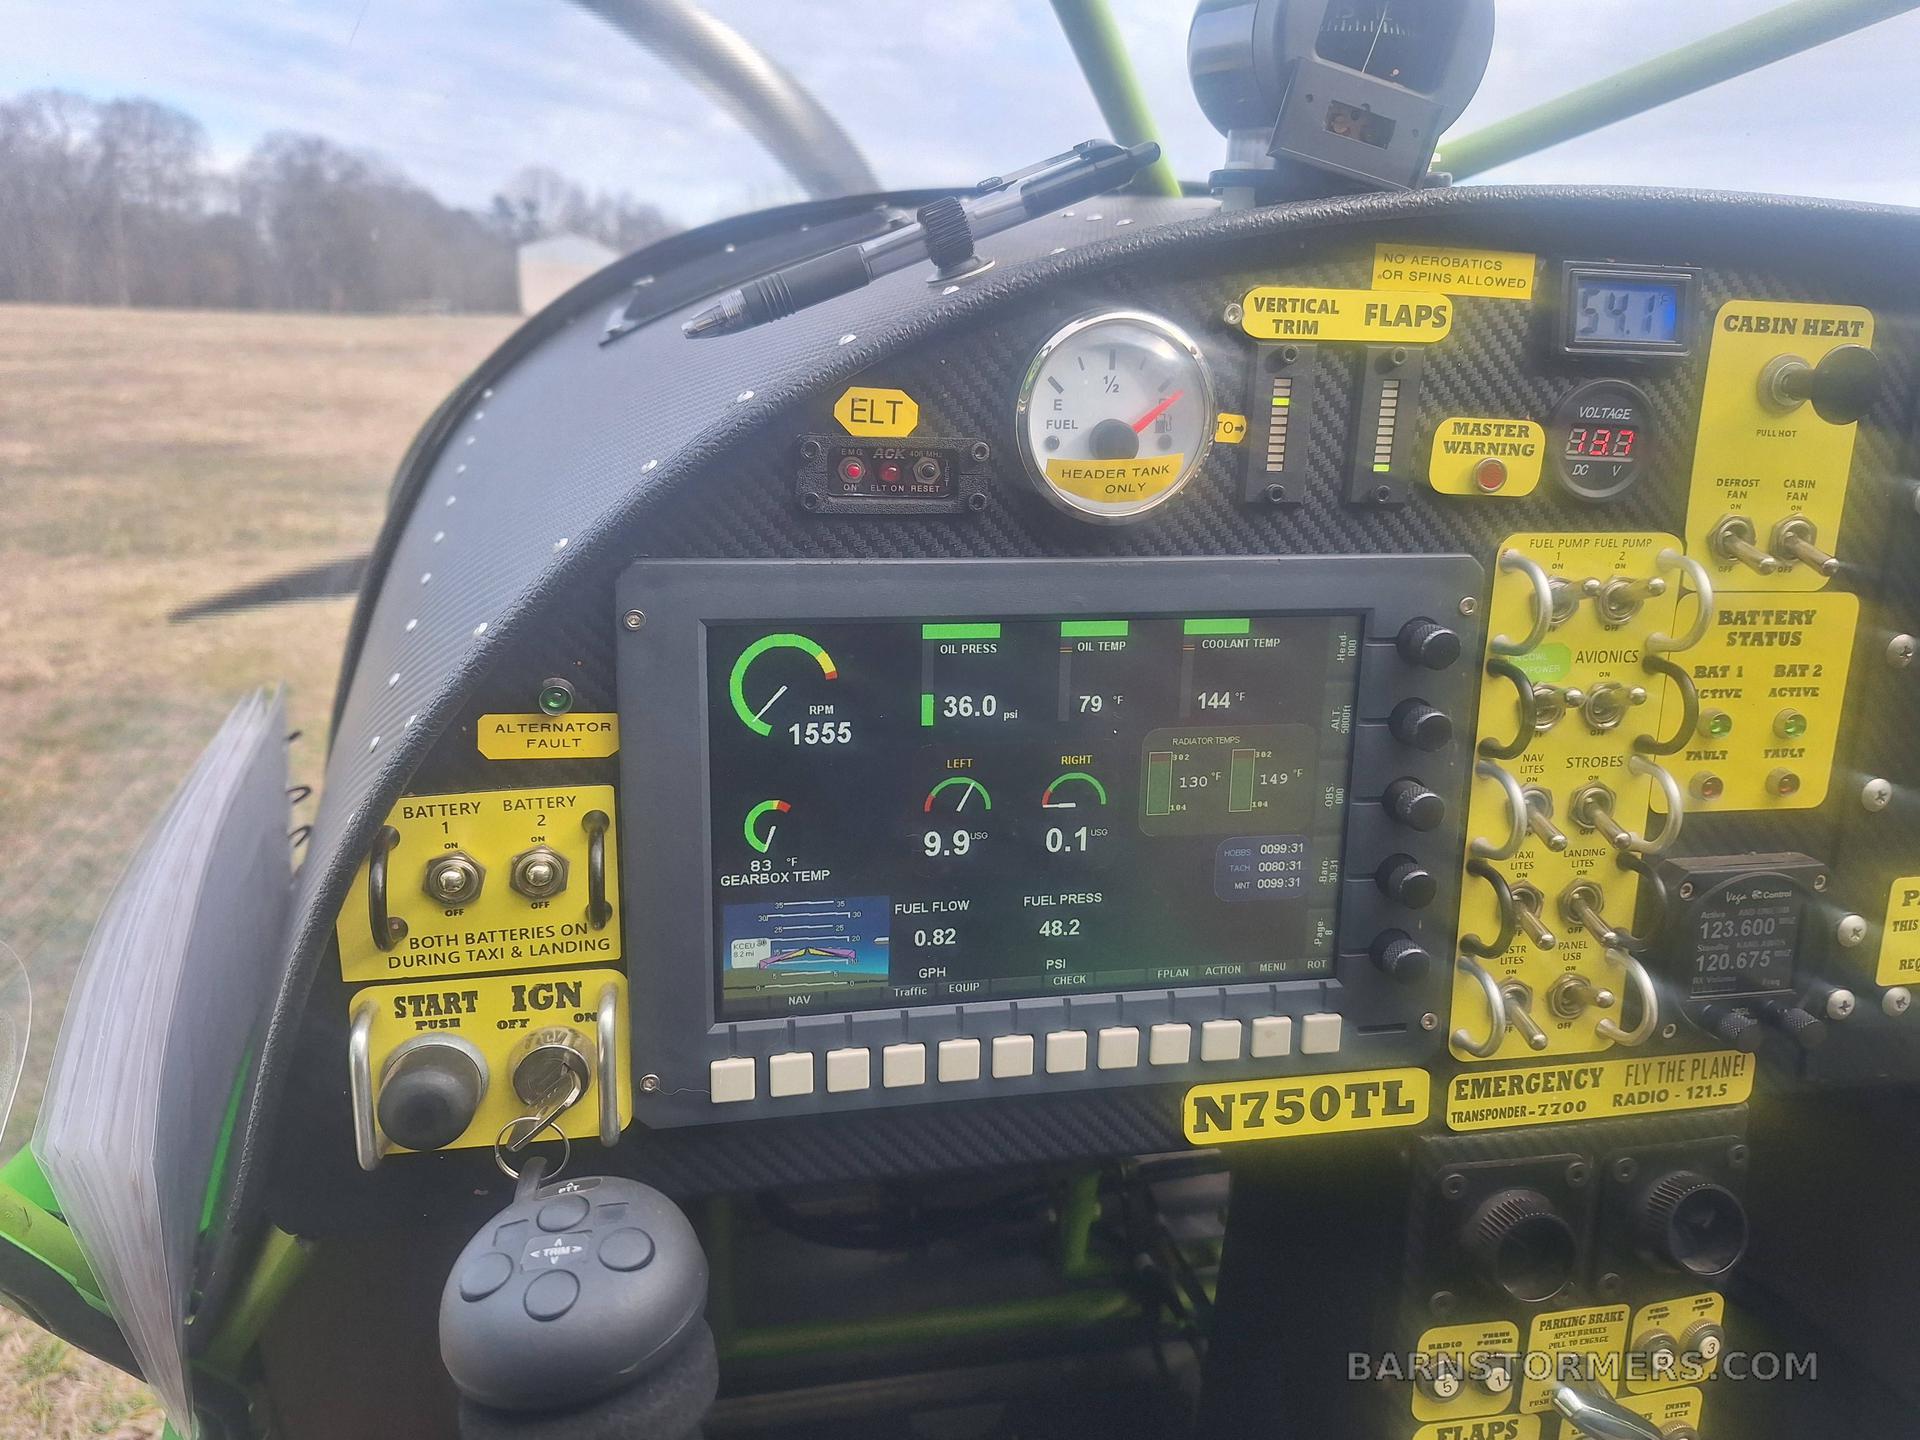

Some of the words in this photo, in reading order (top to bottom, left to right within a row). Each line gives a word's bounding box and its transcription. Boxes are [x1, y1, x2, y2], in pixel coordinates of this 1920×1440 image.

[1384, 253, 1404, 264] NO
[1411, 255, 1503, 271] AEROBATICS
[1382, 269, 1404, 280] OR
[1408, 271, 1452, 284] SPINS
[1457, 273, 1527, 289] ALLOWED
[1254, 296, 1340, 315] VERTICAL
[1364, 304, 1448, 329] FLAPS
[1272, 319, 1319, 335] TRIM
[1724, 314, 1798, 335] CABIN
[1801, 318, 1864, 338] HEAT
[850, 397, 904, 424] ELT
[1054, 399, 1063, 411] E
[1578, 406, 1632, 420] VOLTAGE
[1046, 420, 1079, 430] FUEL
[1452, 422, 1530, 438] MASTER
[1756, 428, 1776, 438] PULL
[1777, 429, 1798, 438] HOT
[1443, 440, 1536, 457] WARNING
[1061, 468, 1126, 479] HEADER
[1132, 464, 1170, 476] TANK
[1572, 464, 1589, 476] DC
[1612, 464, 1622, 476] V
[843, 484, 858, 492] ON
[870, 484, 887, 492] ELT
[890, 484, 905, 492] ON
[1104, 482, 1146, 494] ONLY
[1716, 478, 1760, 488] DEFROST
[1783, 479, 1816, 489] CABIN
[1726, 490, 1748, 499] FAN
[1786, 492, 1808, 501] FAN
[1529, 538, 1554, 549] FUEL
[1558, 538, 1590, 548] PUMP
[1594, 538, 1618, 548] FUEL
[1622, 538, 1652, 548] PUMP
[1618, 552, 1625, 561] 2
[1718, 610, 1817, 626] BATTERY
[1202, 638, 1252, 650] COOLANT
[1252, 638, 1281, 648] TEMP
[1726, 631, 1803, 647] STATUS
[939, 644, 959, 655] OIL
[961, 643, 998, 654] PRESS
[1077, 641, 1094, 652] OIL
[1096, 640, 1127, 652] TEMP
[1575, 650, 1638, 664] AVIONICS
[1694, 665, 1730, 679] BAT
[1773, 664, 1810, 678] BAT
[1812, 664, 1823, 678] 2
[1696, 688, 1743, 699] CTIVE
[1768, 686, 1820, 698] ACTIVE
[1078, 695, 1103, 713] 79
[1197, 692, 1231, 710] 144
[808, 704, 834, 716] RPM
[943, 694, 997, 718] 36.0
[1003, 709, 1018, 721] psi
[494, 722, 612, 734] ALTERNATOR
[788, 721, 852, 746] 1555
[526, 738, 582, 749] FAULT
[1172, 736, 1214, 746] RADIATOR
[946, 758, 974, 769] LEFT
[1061, 754, 1094, 765] RIGHT
[1522, 754, 1545, 762] NAV
[1566, 756, 1624, 769] STROBES
[1520, 764, 1545, 774] LITES
[1179, 775, 1208, 789] 130
[1260, 773, 1288, 786] 149
[502, 795, 577, 812] BATTERY
[402, 801, 482, 820] BATTERY
[536, 814, 546, 827] 2
[441, 822, 450, 834] 1
[530, 835, 546, 843] ON
[923, 829, 971, 857] 9.9
[1045, 826, 1088, 854] 0.1
[444, 842, 459, 850] ON
[1260, 842, 1304, 855] 0099:31
[1563, 848, 1606, 858] LANDING
[750, 860, 772, 872] 83
[1229, 864, 1251, 873] TACH
[1258, 860, 1302, 872] 0080:31
[1510, 861, 1534, 871] LITES
[1571, 859, 1595, 868] LITES
[720, 871, 790, 887] GEARBOX
[794, 869, 831, 884] TEMP
[1234, 880, 1251, 890] MNT
[1256, 877, 1301, 890] 0099:31
[530, 901, 551, 910] OFF
[1023, 896, 1057, 908] FUEL
[1060, 892, 1103, 906] PRESS
[445, 908, 465, 917] OFF
[894, 902, 929, 915] FUEL
[932, 900, 970, 913] FLOW
[1038, 918, 1081, 938] 48.2
[1700, 918, 1776, 939] 123.600
[1892, 920, 1919, 932] THIS
[409, 933, 459, 950] BOTH
[465, 926, 556, 945] BATTERIES
[560, 922, 588, 936] ON
[914, 927, 957, 947] 0.82
[1558, 940, 1589, 950] PANEL
[388, 951, 461, 970] DURING
[467, 947, 505, 963] TAXI
[510, 946, 523, 958] &
[529, 938, 611, 957] LANDING
[1562, 952, 1582, 962] USB
[1046, 959, 1066, 970] PSI
[1307, 959, 1328, 970] ROT
[1500, 956, 1524, 966] LITES
[1695, 950, 1771, 972] 120.675
[918, 967, 947, 979] GPH
[1157, 968, 1190, 979] FPLAN
[1205, 964, 1242, 976] ACTION
[1259, 962, 1287, 973] MENU
[1053, 974, 1087, 986] CHECK
[894, 986, 928, 998] Traffic
[948, 982, 981, 994] EQUIP
[511, 980, 582, 1012] IGN
[788, 994, 811, 1006] NAV
[393, 990, 478, 1019] START
[573, 1011, 598, 1024] ON
[415, 1018, 461, 1030] PUSH
[496, 1018, 531, 1030] OFF
[1624, 1062, 1652, 1088] FLY
[1658, 1059, 1686, 1084] THE
[1690, 1054, 1746, 1081] PLANE!
[1454, 1066, 1604, 1102] EMERGENCY
[1612, 1088, 1670, 1108] RADIO
[1686, 1083, 1728, 1100] 121.5
[1192, 1079, 1416, 1134] N750TL
[1539, 1313, 1586, 1332] PARKING
[1588, 1310, 1625, 1325] BRAKE
[1708, 1342, 1716, 1355] 3
[1495, 1375, 1502, 1387] 1
[1443, 1381, 1453, 1394] 5
[1436, 1419, 1519, 1440] FLAPS
